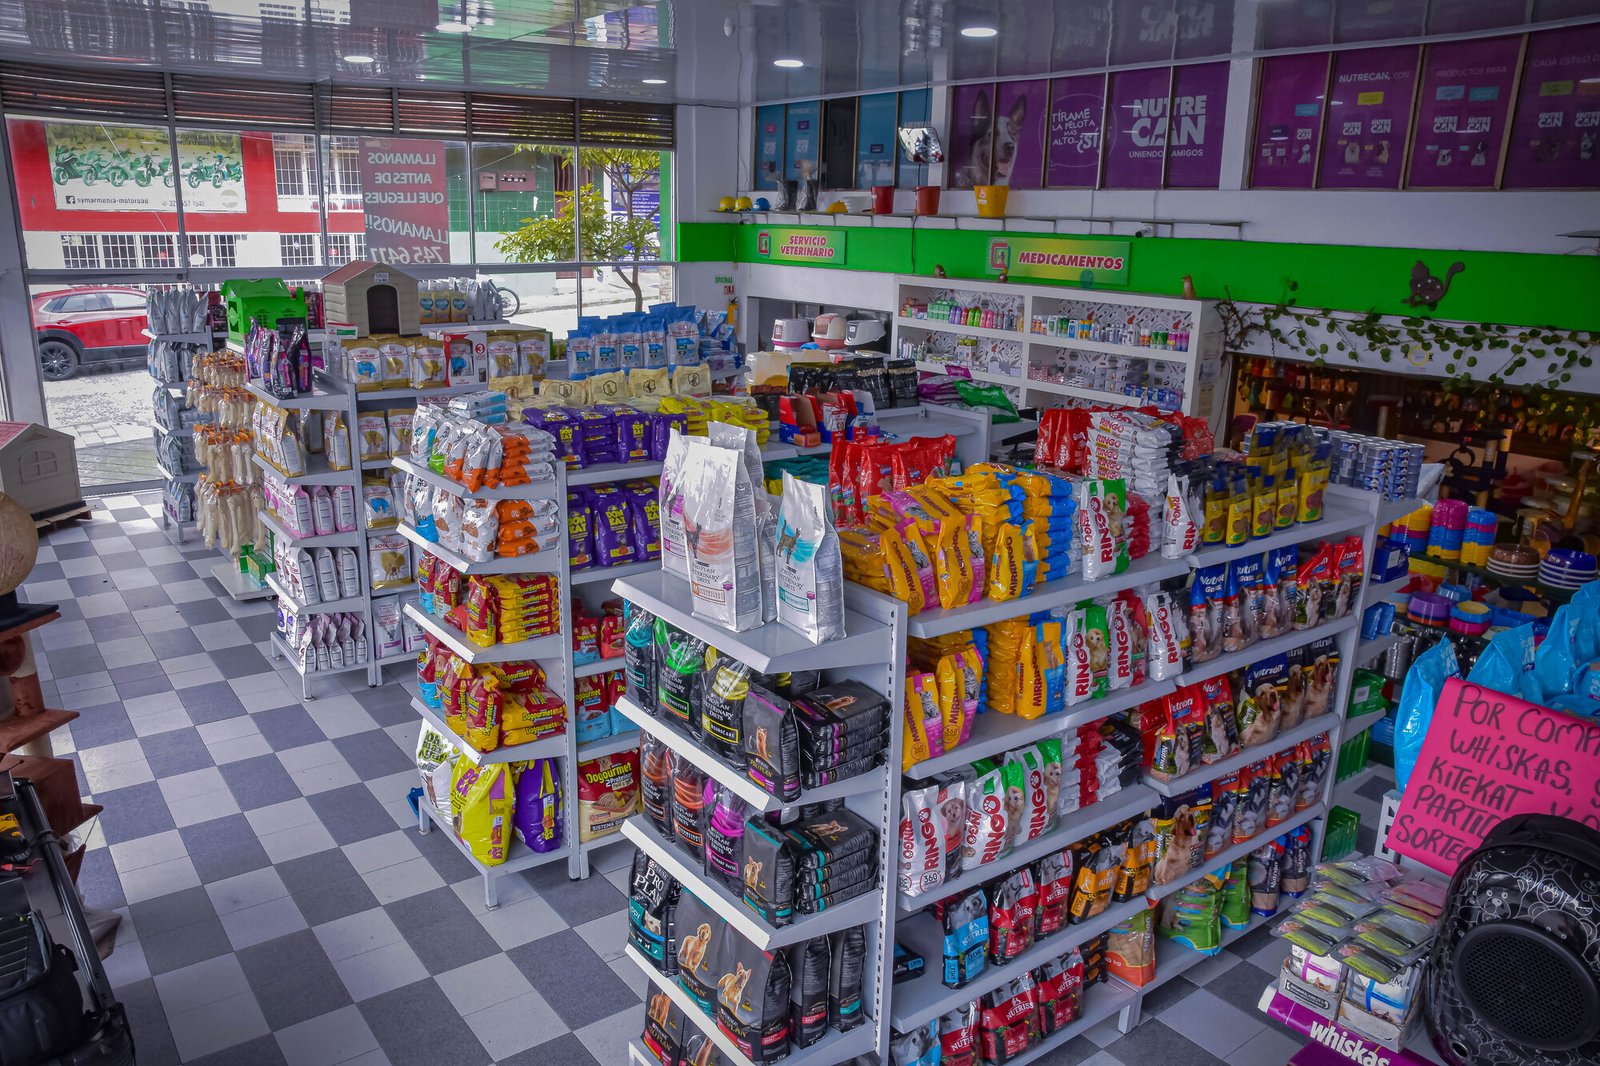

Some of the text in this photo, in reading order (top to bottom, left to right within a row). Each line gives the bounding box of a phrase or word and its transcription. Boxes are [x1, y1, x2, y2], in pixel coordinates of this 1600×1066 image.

[1339, 71, 1391, 83] NUTRECAN,
[1132, 95, 1207, 118] NUTRE
[1130, 115, 1206, 147] CAN
[1170, 149, 1204, 157] AMIGOS
[780, 246, 835, 258] VETERINARIO
[789, 235, 827, 246] SERVICIO
[1018, 251, 1124, 270] MEDICAMENTOS
[1099, 418, 1124, 433] RINGO
[1096, 434, 1121, 448] RINGO
[1096, 447, 1119, 460] RINGO
[1090, 497, 1113, 563] RINGO
[1183, 520, 1198, 550] RIN
[1006, 536, 1018, 596] MIRRINGO
[1114, 616, 1130, 678] RINGO
[1157, 607, 1179, 664] RINGO
[1032, 646, 1042, 707] MIRRINGO
[1073, 633, 1090, 696] RINGO
[575, 688, 601, 701] ogourmet
[1453, 685, 1505, 730] POR
[586, 761, 633, 785] Dogourmet
[1028, 770, 1047, 840] RINGO
[592, 821, 615, 832] SISTEMA
[981, 795, 1005, 865] RINGO
[918, 807, 940, 871] RINGO
[645, 867, 664, 891] PRO
[1271, 861, 1279, 888] Nutrion
[633, 874, 662, 907] PLAN
[962, 928, 989, 946] NUTRIS
[1057, 975, 1081, 994] NUTRISS
[1007, 1001, 1034, 1020] NUTRISS
